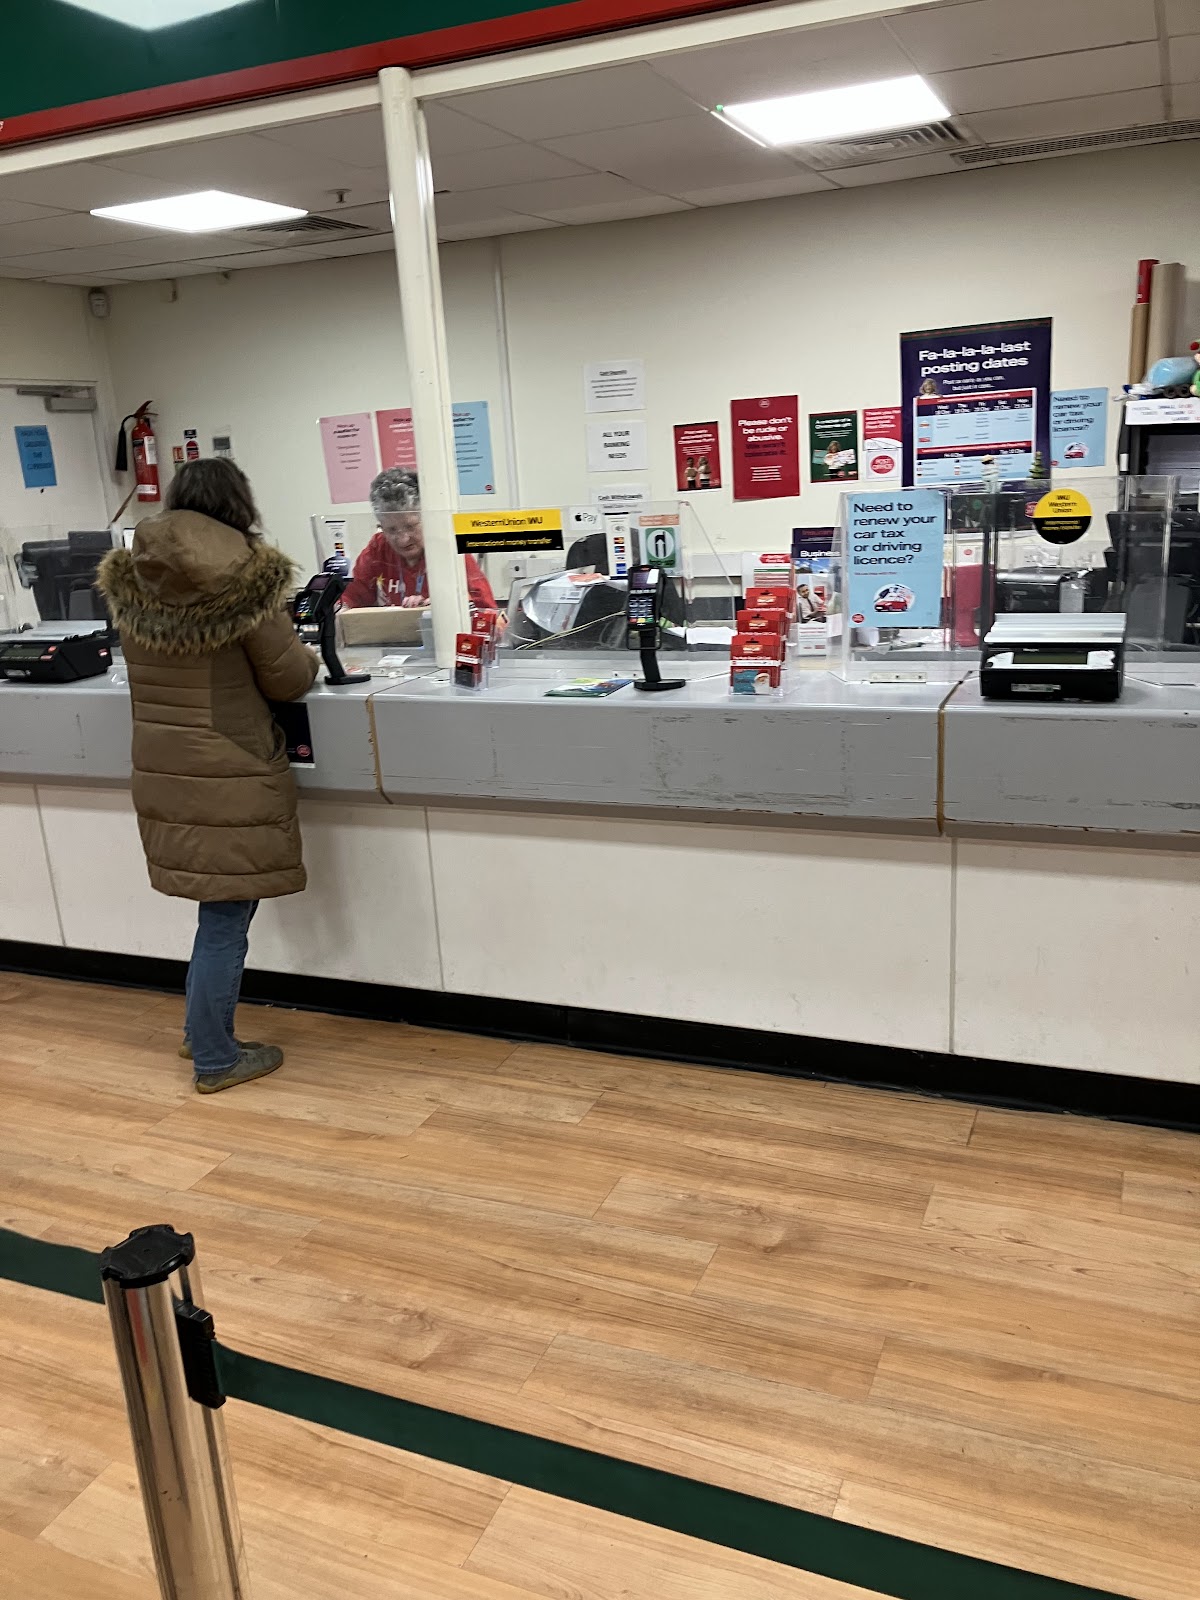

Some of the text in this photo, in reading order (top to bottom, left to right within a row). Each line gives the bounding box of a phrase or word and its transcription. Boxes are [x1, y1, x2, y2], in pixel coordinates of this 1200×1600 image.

[918, 340, 1032, 361] Fa-la-la-la-last
[921, 357, 1029, 377] posting dates
[768, 416, 793, 424] don't
[747, 434, 784, 442] abusive.
[853, 502, 913, 513] Need to
[582, 512, 598, 524] Pay
[853, 515, 937, 527] renew your
[853, 528, 906, 539] car tax
[466, 538, 505, 547] International
[527, 537, 552, 545] transfer
[853, 541, 922, 553] or driving
[800, 549, 840, 557] Business
[853, 554, 915, 566] licence?
